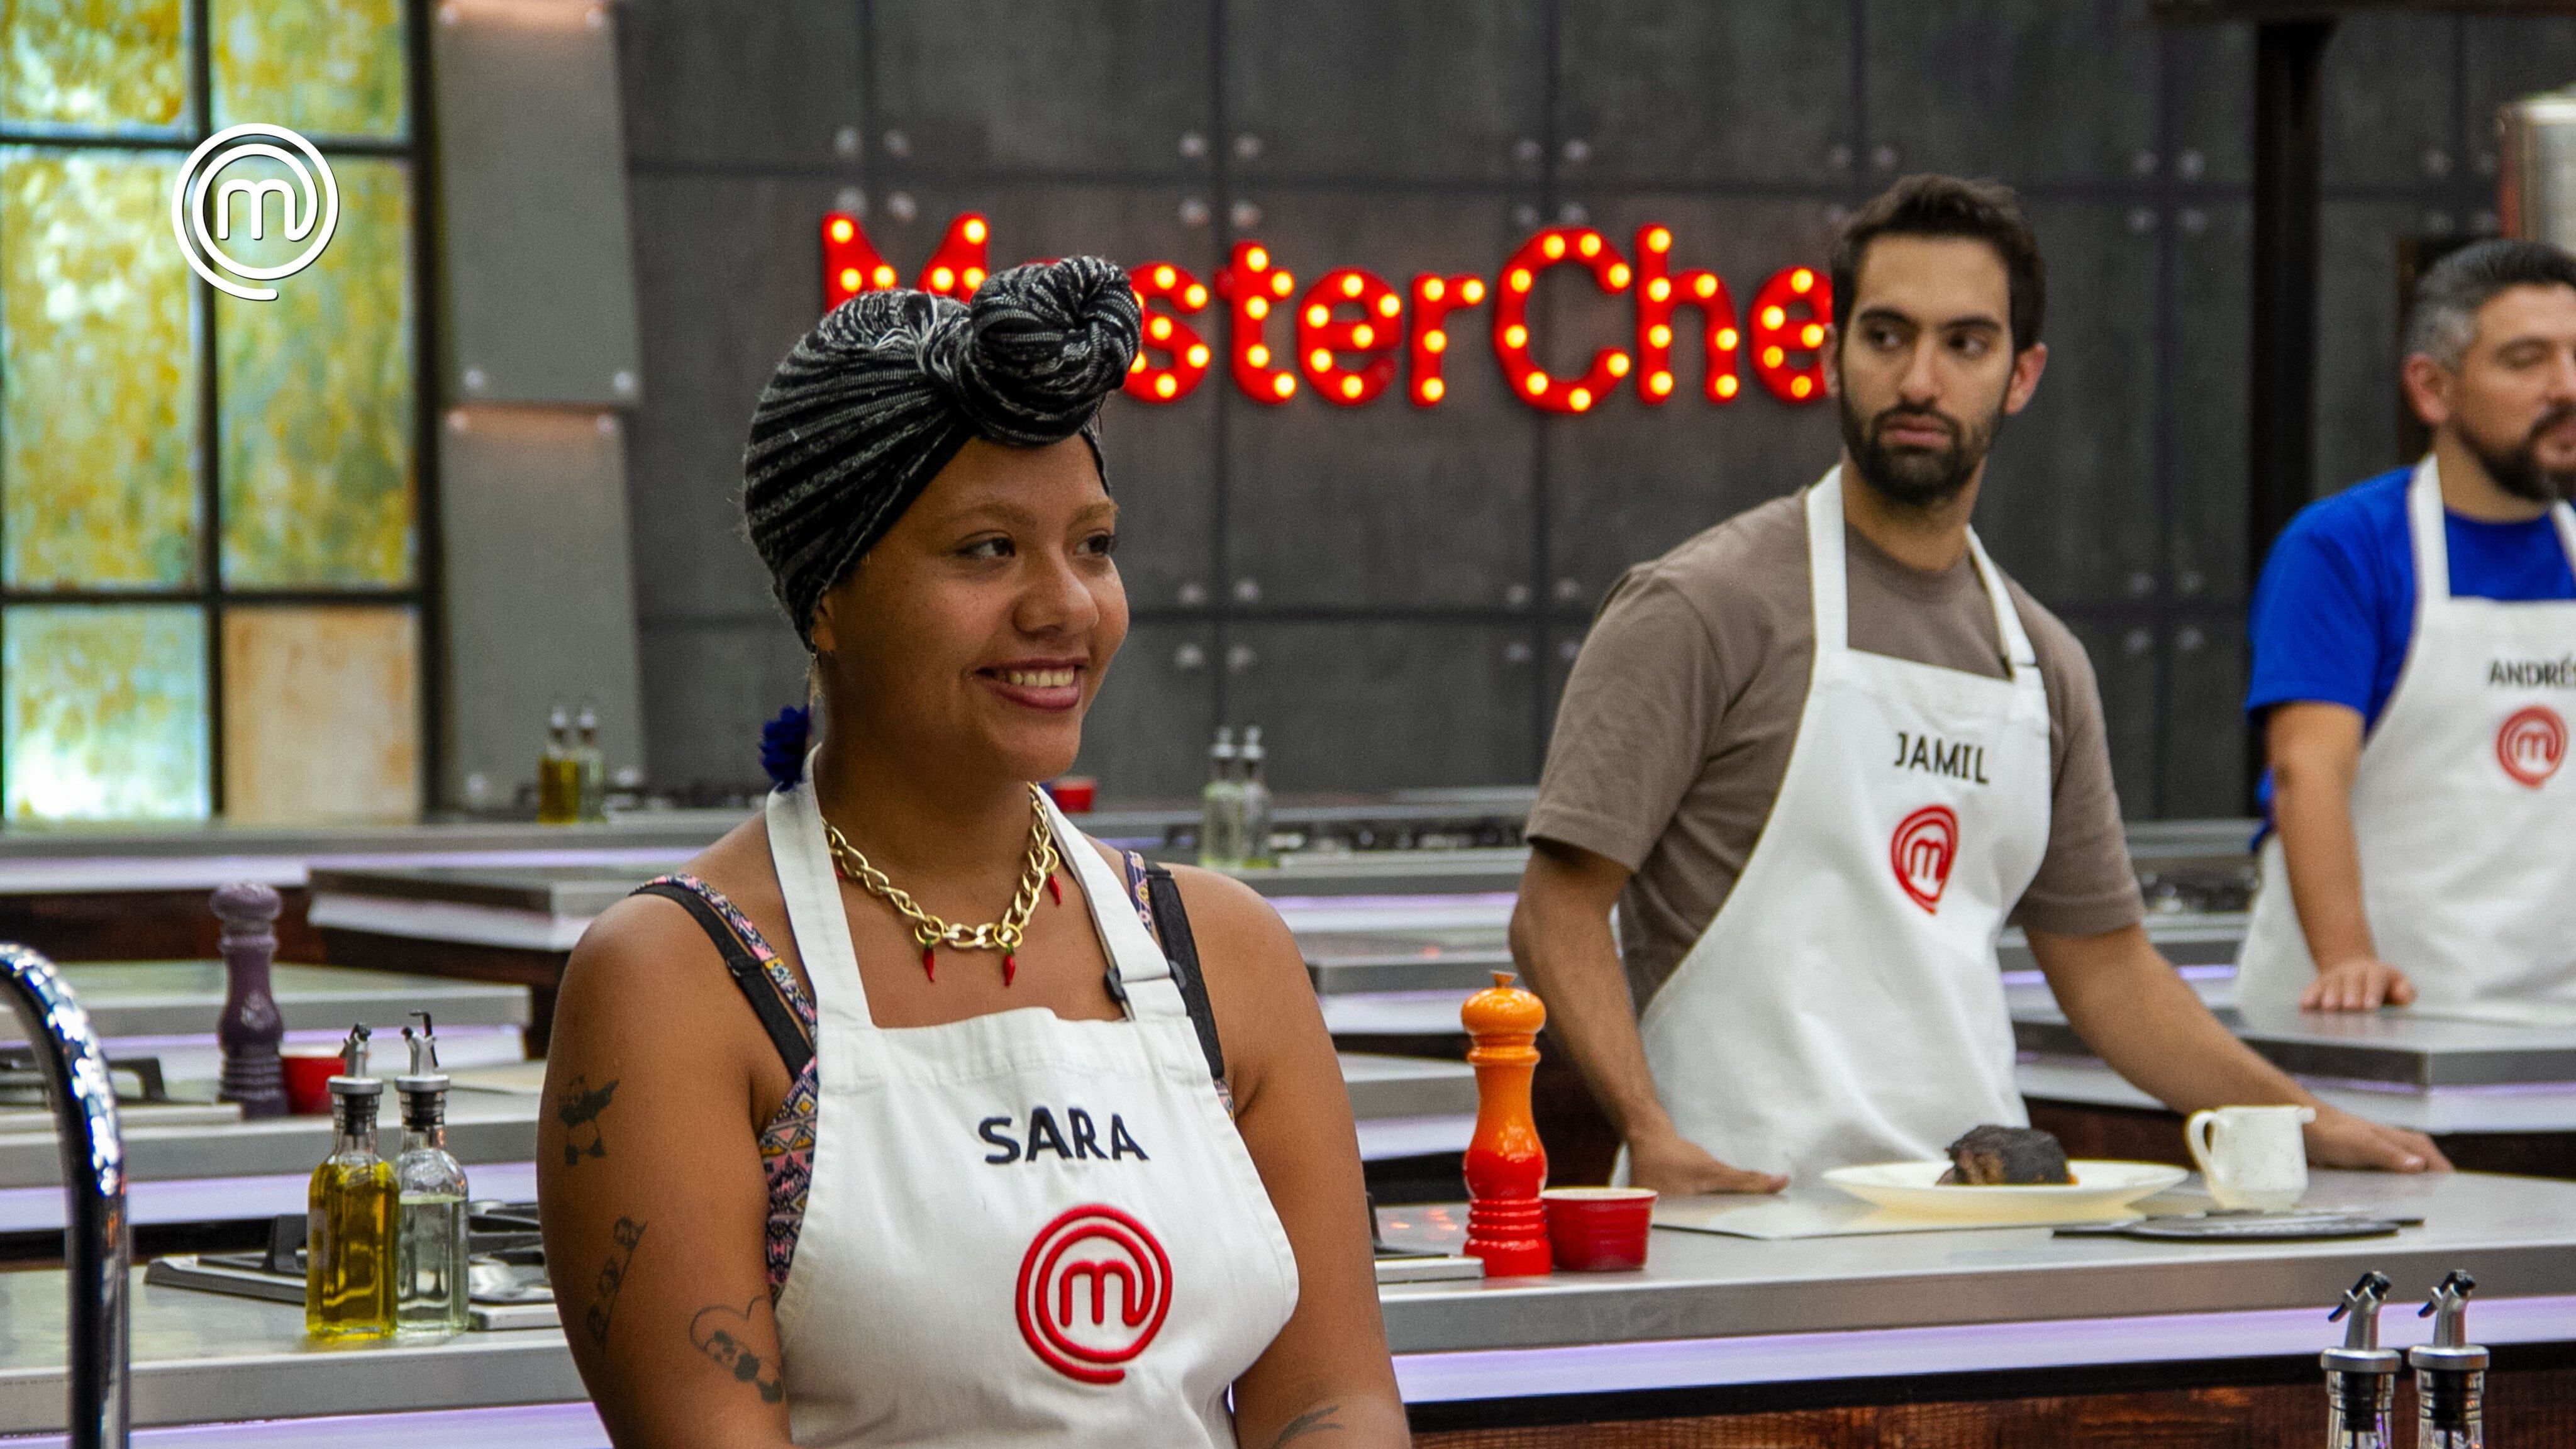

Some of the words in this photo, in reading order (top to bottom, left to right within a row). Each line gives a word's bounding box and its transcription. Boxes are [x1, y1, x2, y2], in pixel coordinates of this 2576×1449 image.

[821, 209, 1834, 413] MsterChe
[2489, 652, 2576, 687] ANDRÉ
[1894, 731, 1990, 785] JAMIL
[978, 1105, 1150, 1165] SARA
